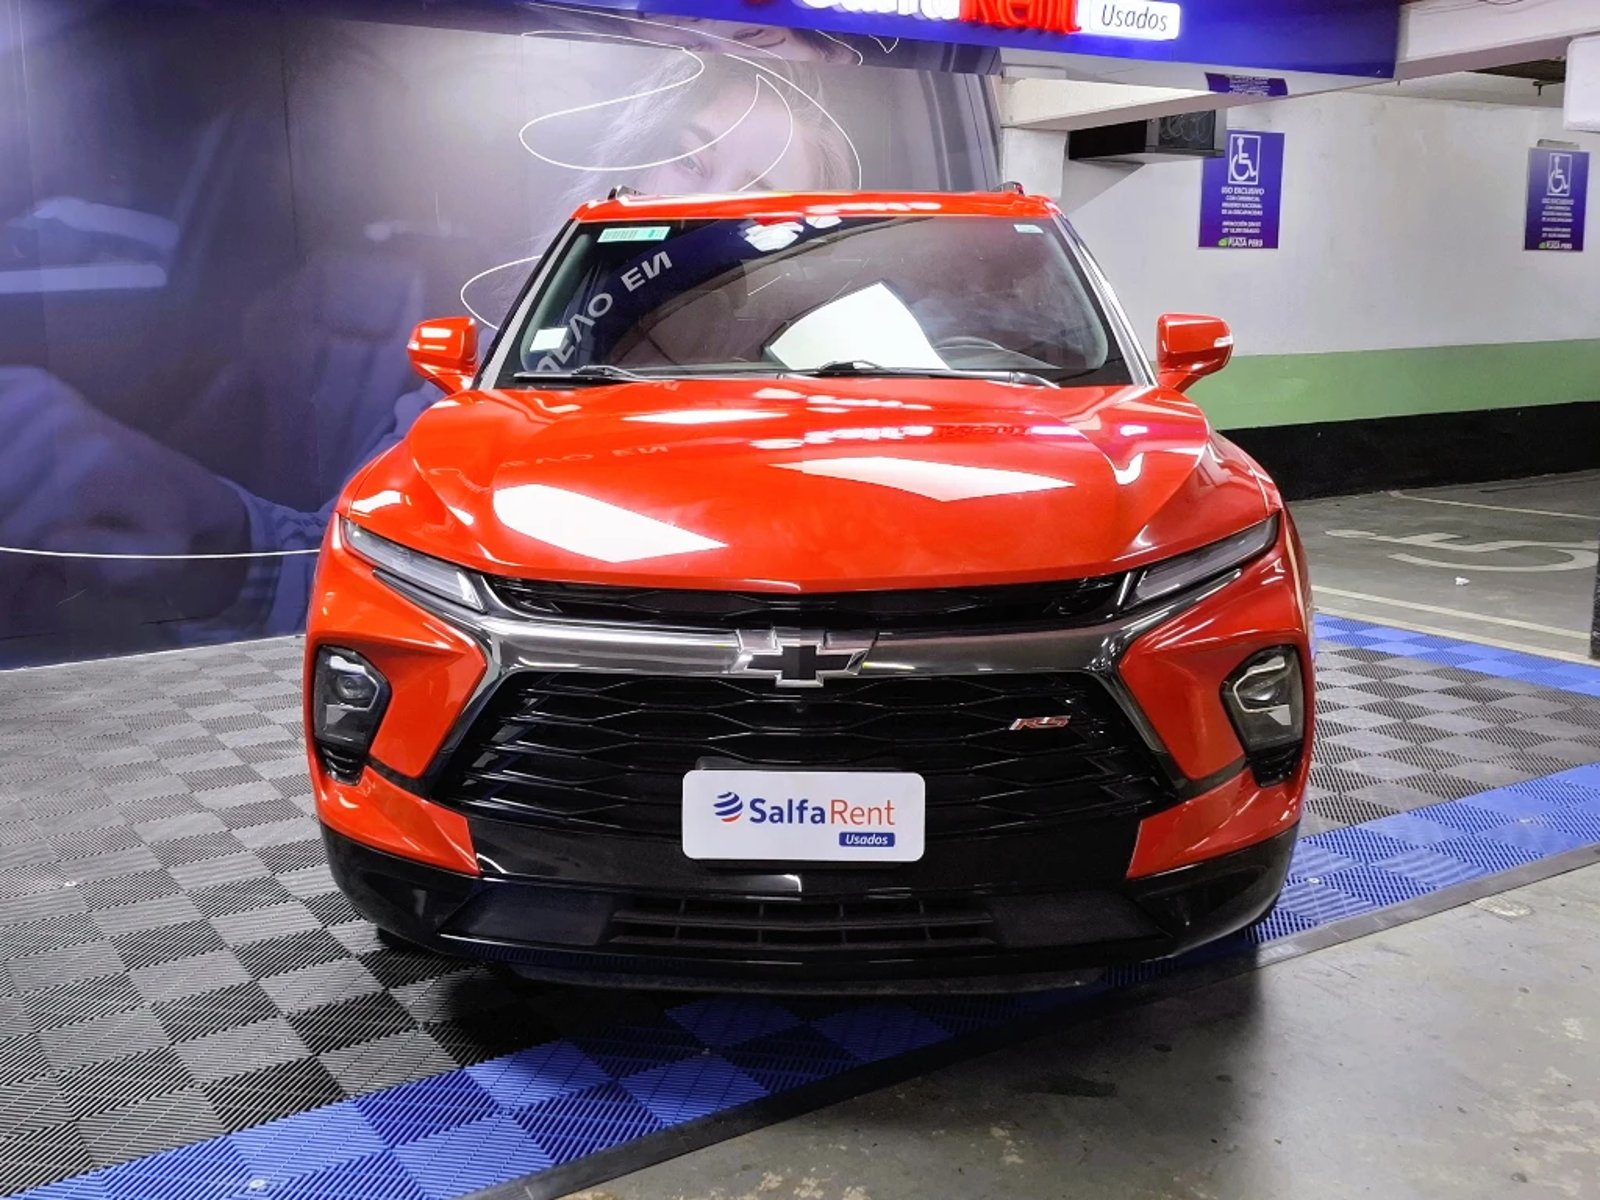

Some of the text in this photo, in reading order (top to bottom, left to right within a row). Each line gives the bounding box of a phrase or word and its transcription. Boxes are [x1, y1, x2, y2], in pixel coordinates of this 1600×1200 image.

[1101, 4, 1168, 32] Usados
[1009, 714, 1072, 731] RS
[750, 798, 896, 826] SalfaRent
[845, 834, 888, 845] Usados
